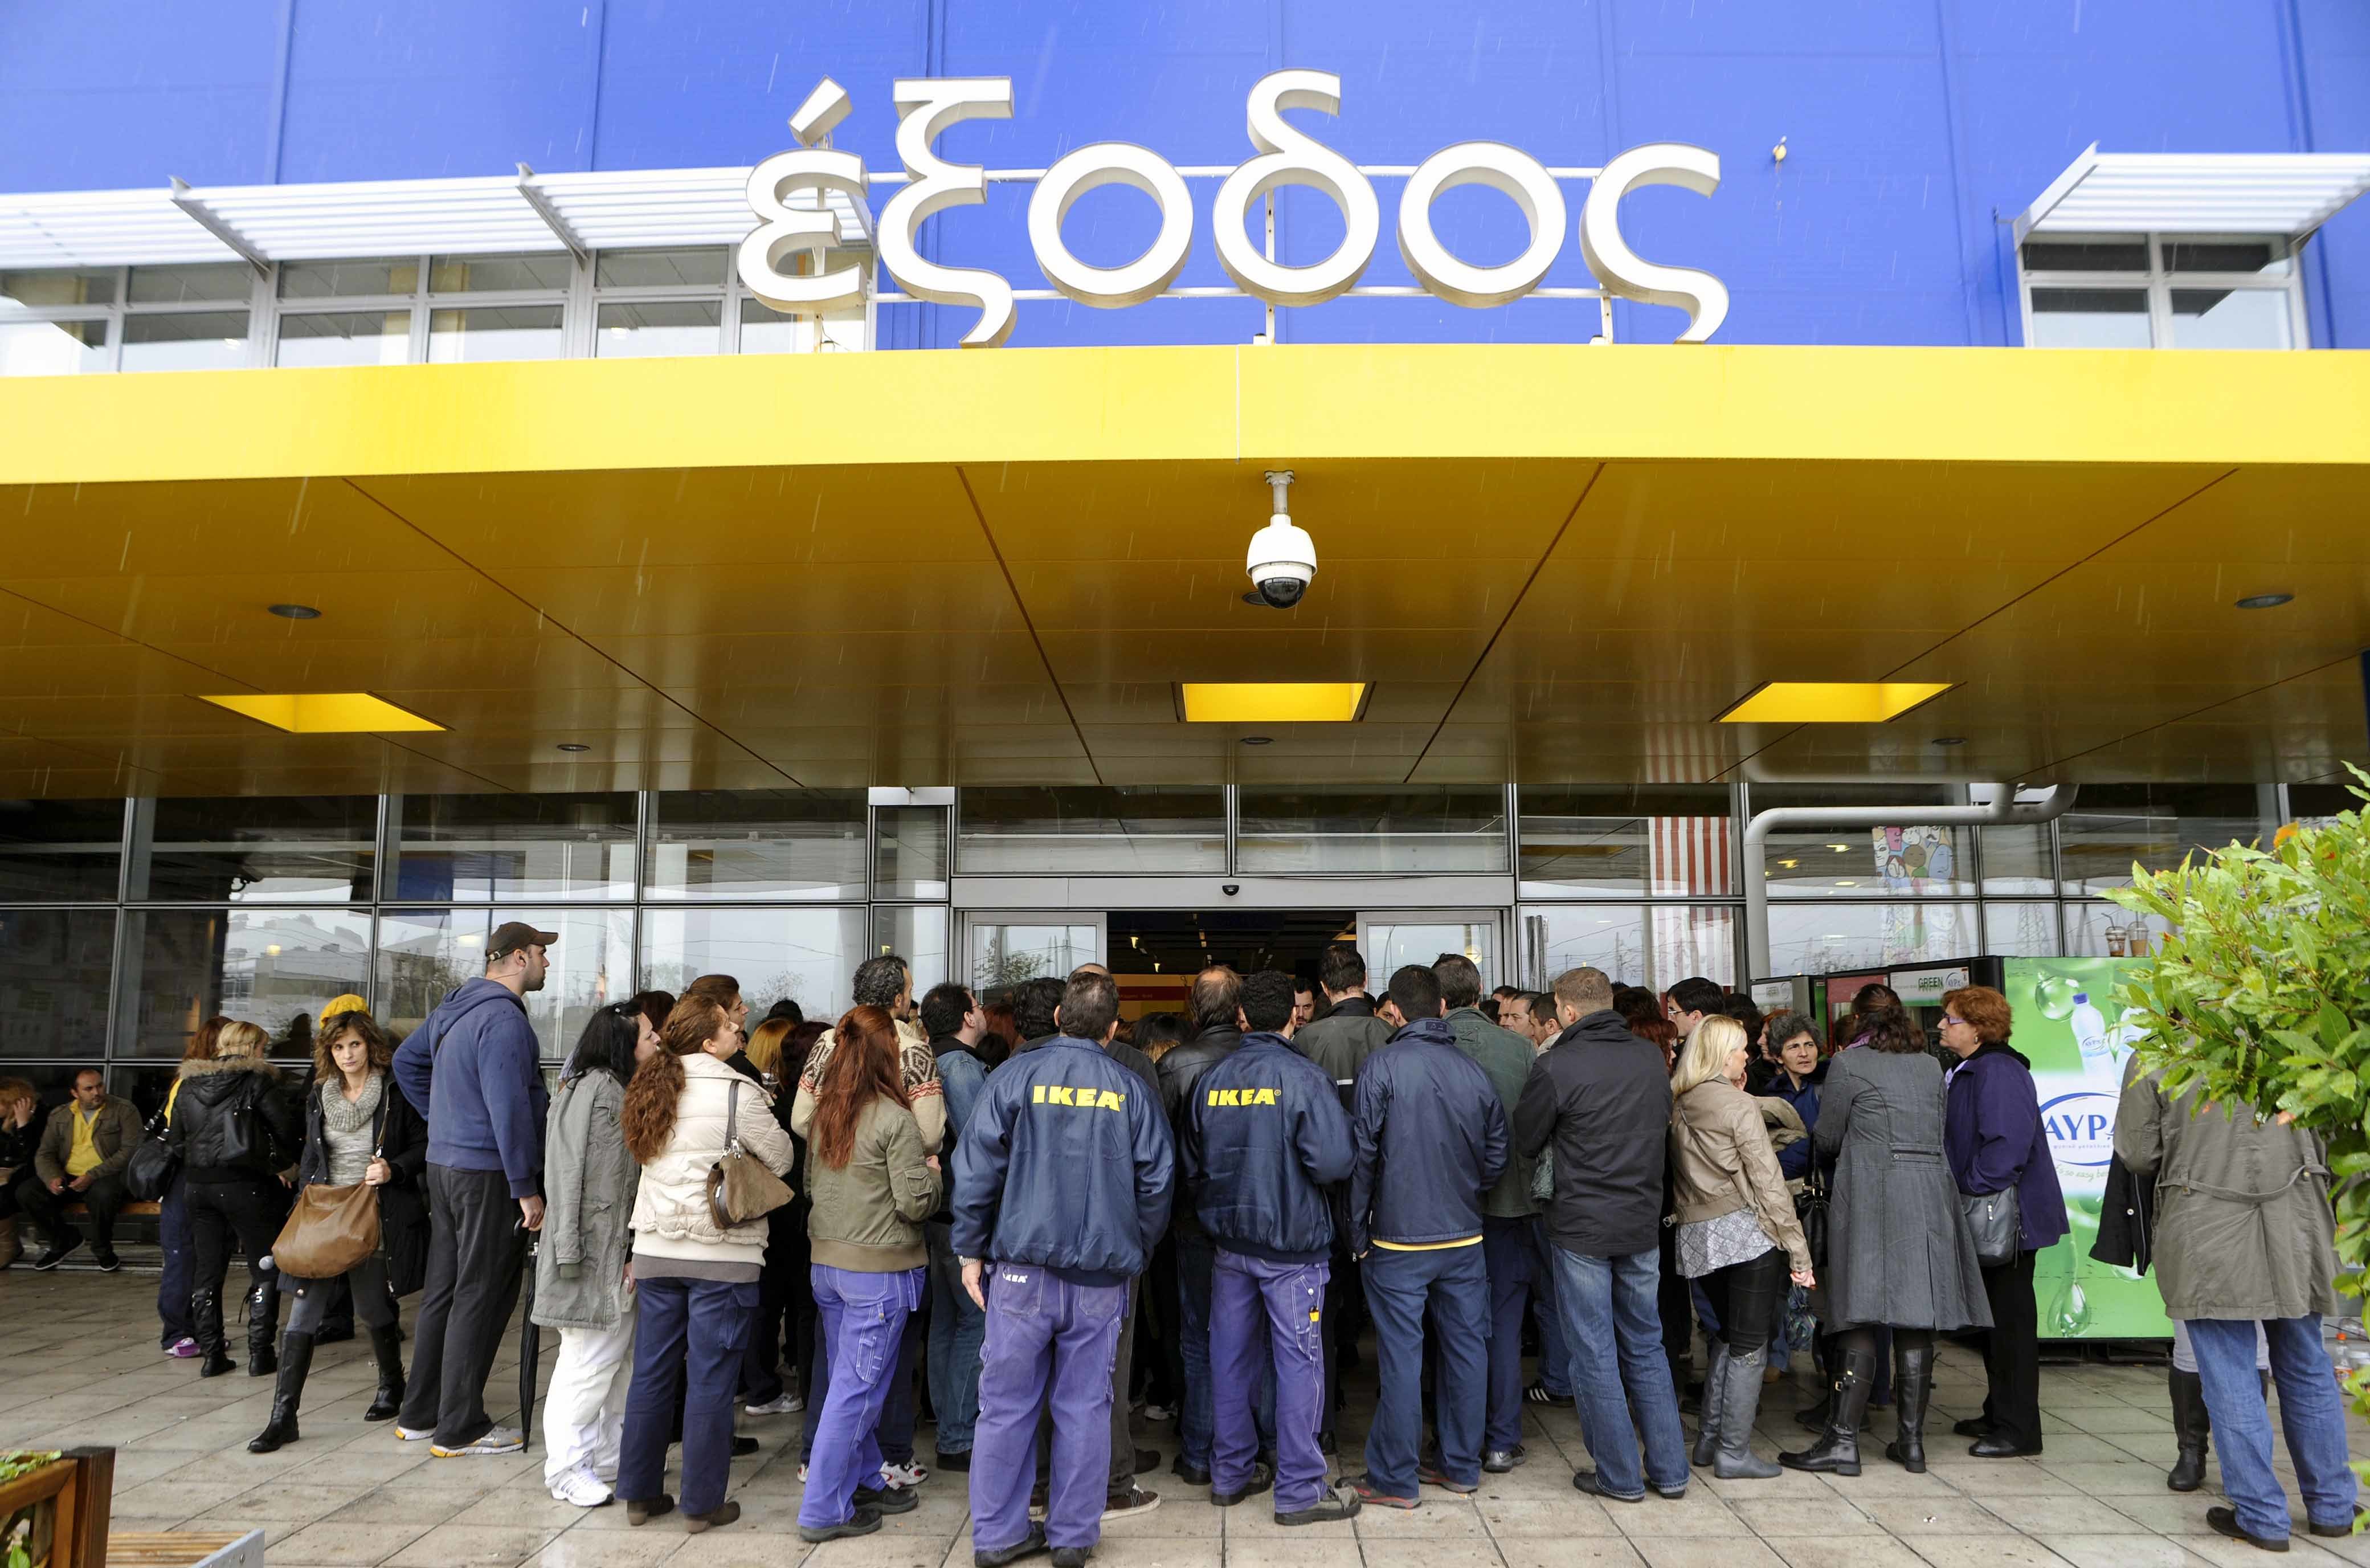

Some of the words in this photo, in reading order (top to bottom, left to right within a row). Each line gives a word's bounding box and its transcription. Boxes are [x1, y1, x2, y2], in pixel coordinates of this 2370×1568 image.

[737, 68, 1730, 348] έξοδος
[1918, 976, 1943, 989] GREEN
[2045, 1114, 2115, 1141] ΑΥΡ
